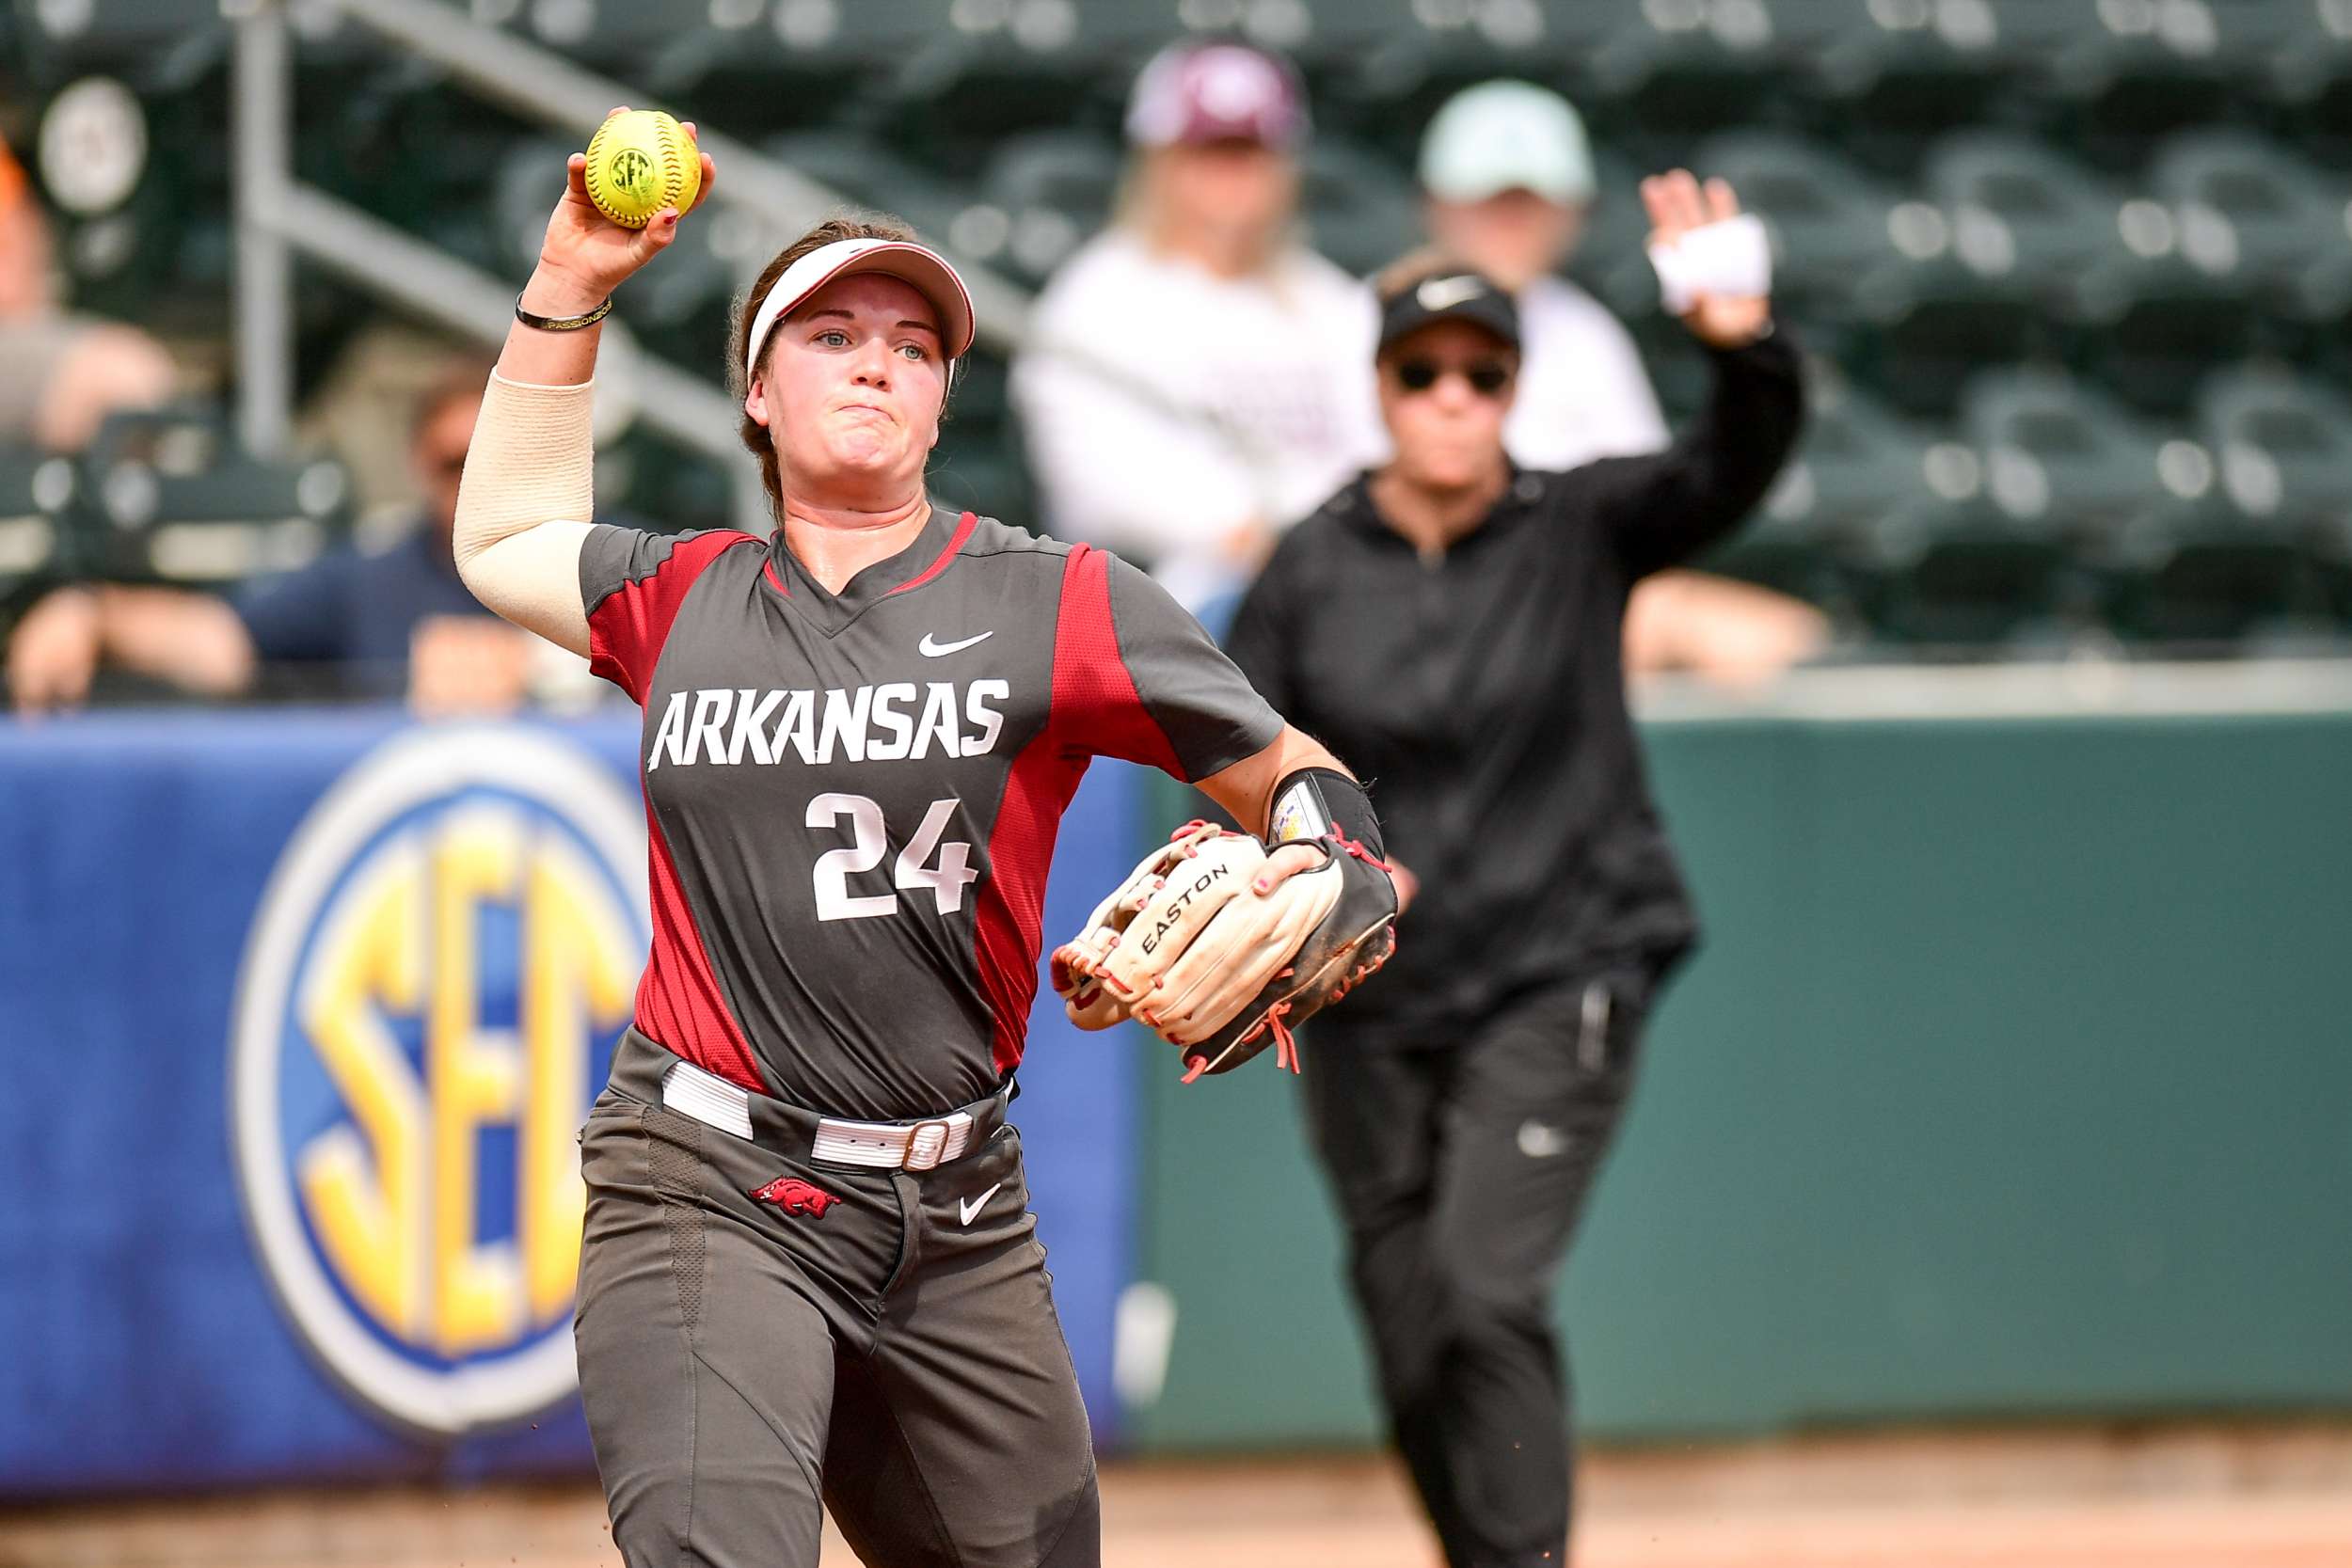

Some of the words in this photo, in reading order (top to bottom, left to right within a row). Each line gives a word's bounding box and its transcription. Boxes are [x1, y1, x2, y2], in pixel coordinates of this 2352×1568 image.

[647, 678, 1009, 772] ARKANSAS
[804, 792, 978, 922] 24
[1141, 863, 1230, 957] EASTON
[300, 801, 630, 1353] SEC
